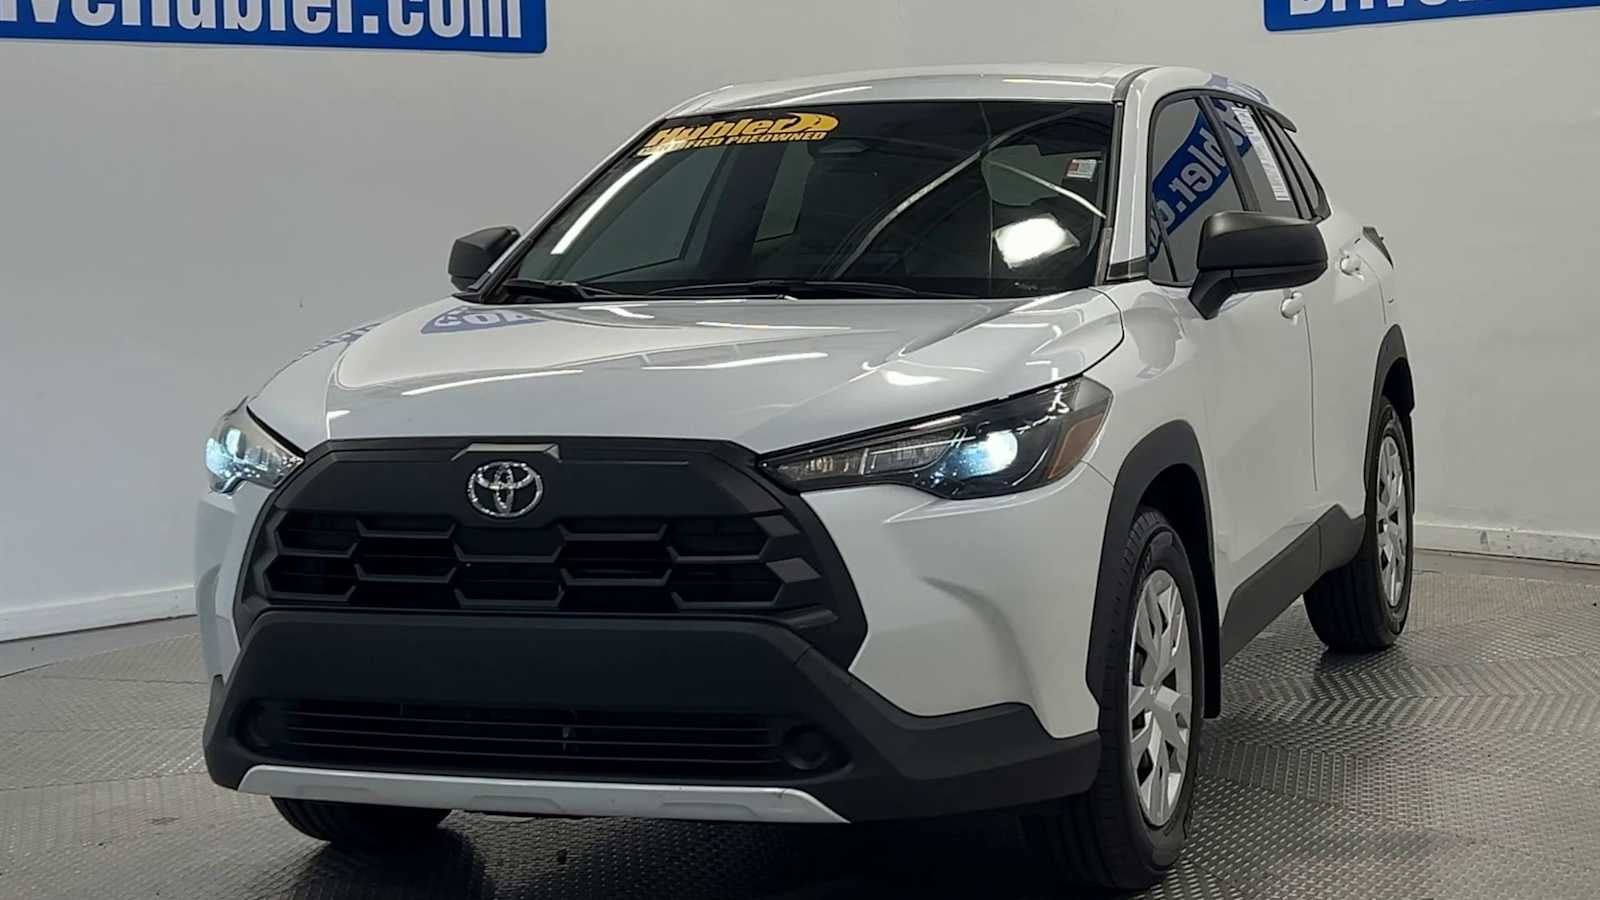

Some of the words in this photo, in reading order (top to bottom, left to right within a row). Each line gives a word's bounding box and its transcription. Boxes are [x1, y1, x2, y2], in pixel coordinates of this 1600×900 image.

[636, 137, 724, 156] CFIED
[724, 132, 828, 145] PREOWNED
[643, 117, 803, 148] Hubler
